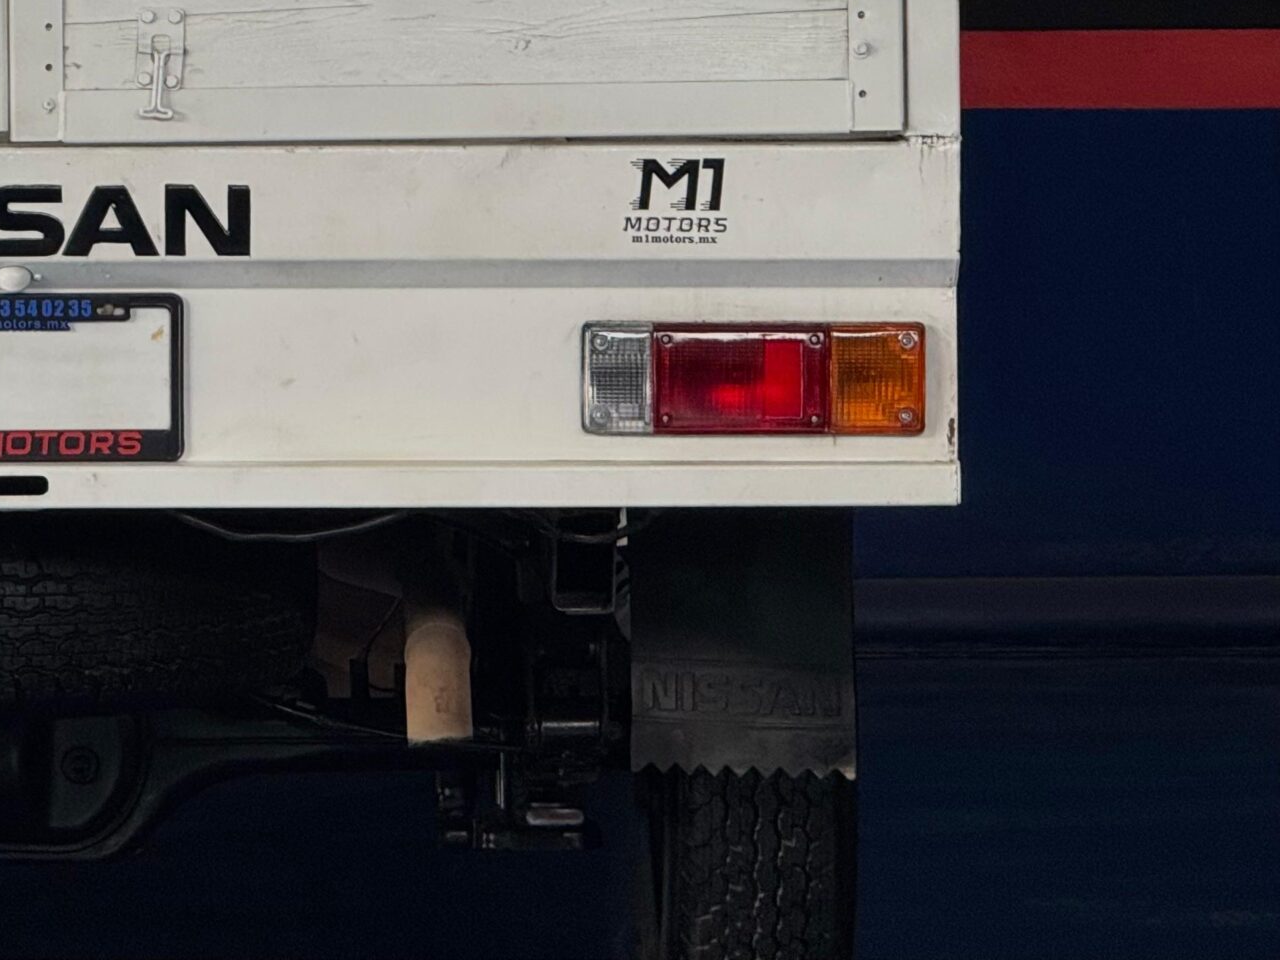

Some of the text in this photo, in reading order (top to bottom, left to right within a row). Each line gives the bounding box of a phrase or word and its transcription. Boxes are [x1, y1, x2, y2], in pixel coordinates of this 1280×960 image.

[629, 157, 725, 211] M1
[623, 216, 728, 233] MOTORS
[631, 234, 718, 245] m1motors.mx
